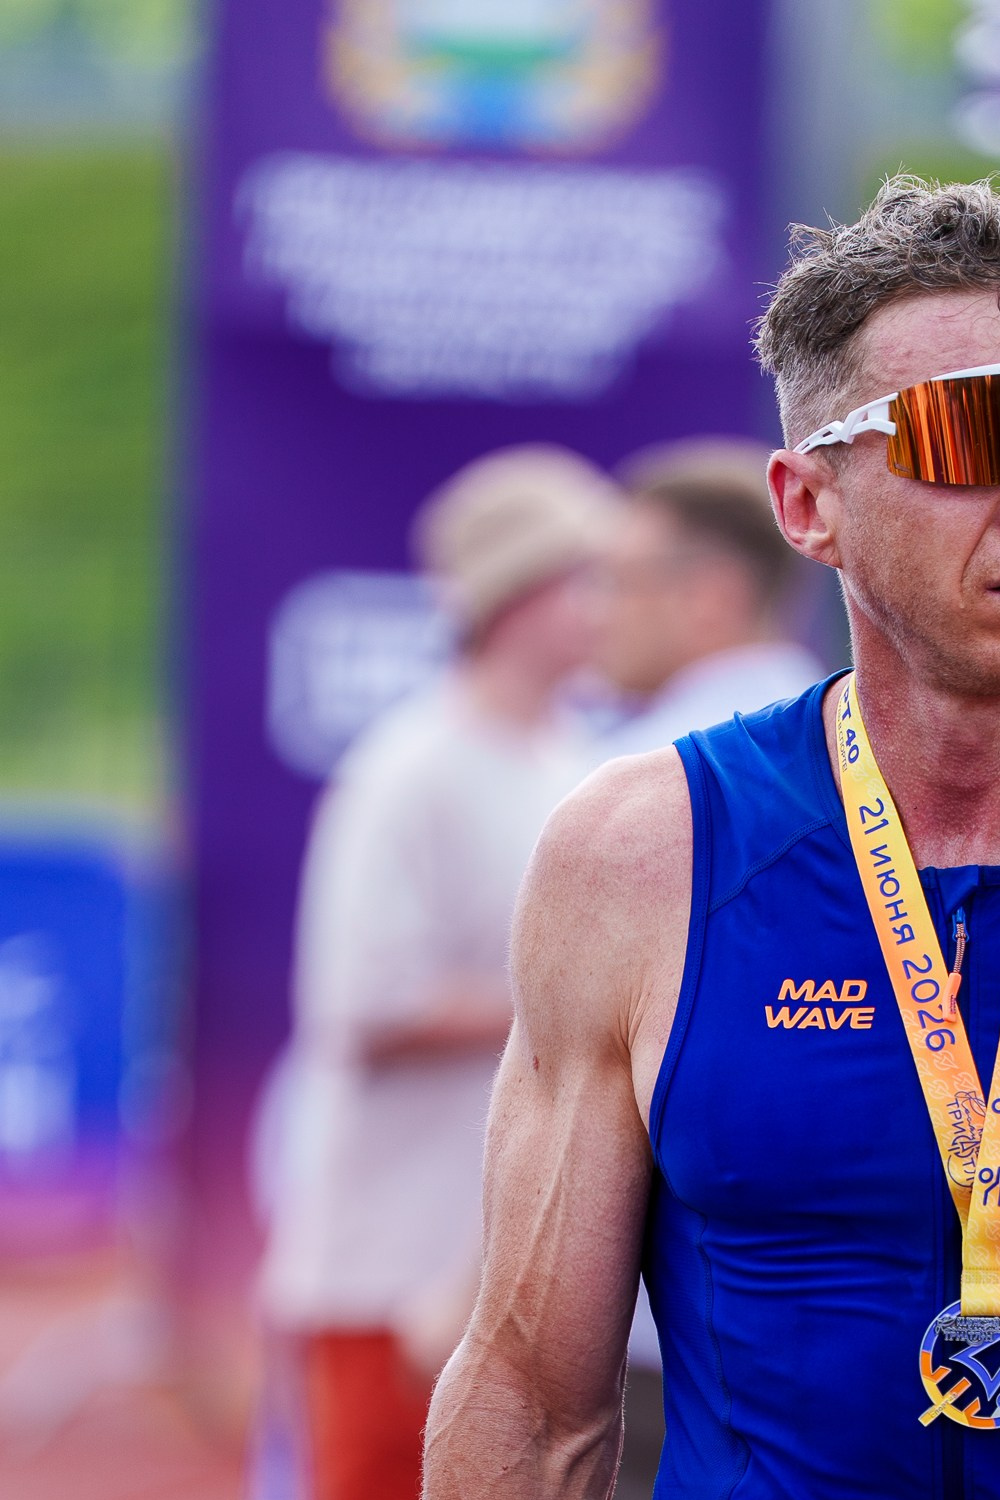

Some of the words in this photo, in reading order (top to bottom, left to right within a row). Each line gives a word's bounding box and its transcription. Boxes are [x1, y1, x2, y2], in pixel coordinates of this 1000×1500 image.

[845, 728, 860, 764] 40
[859, 797, 889, 835] 21
[902, 953, 956, 1052] 2026
[777, 978, 868, 1002] MAD
[765, 1005, 875, 1030] WAVE
